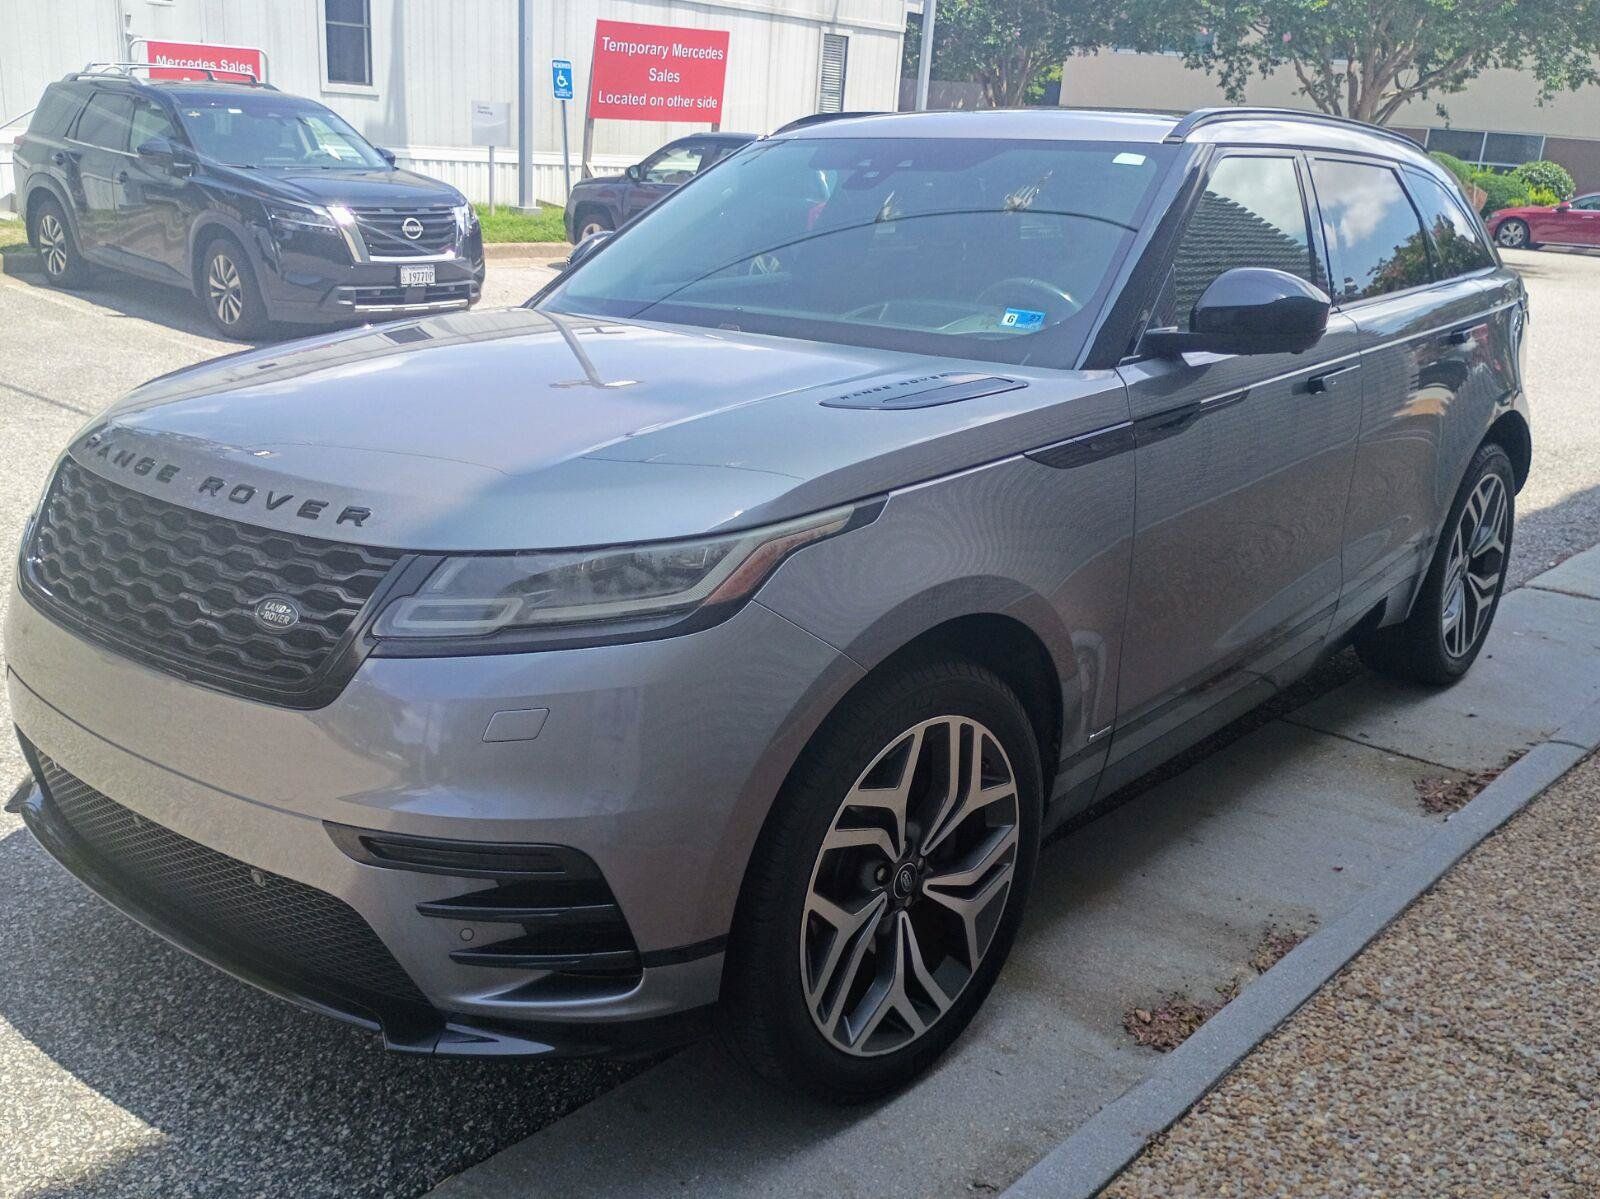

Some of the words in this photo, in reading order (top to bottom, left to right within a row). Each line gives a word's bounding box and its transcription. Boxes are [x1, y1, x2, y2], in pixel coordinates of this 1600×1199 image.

[602, 36, 669, 60] Temporary
[672, 43, 724, 60] Mercedes
[155, 54, 218, 70] Mercedes
[219, 59, 254, 75] Sales
[648, 67, 681, 83] Sales
[598, 90, 647, 106] Located
[649, 97, 664, 107] on
[666, 95, 695, 108] other
[696, 97, 719, 109] side
[1006, 314, 1016, 324] 6
[84, 435, 181, 484] RANGE
[198, 475, 374, 528] ROVER
[264, 601, 287, 614] LAND
[263, 610, 291, 625] ROVER
